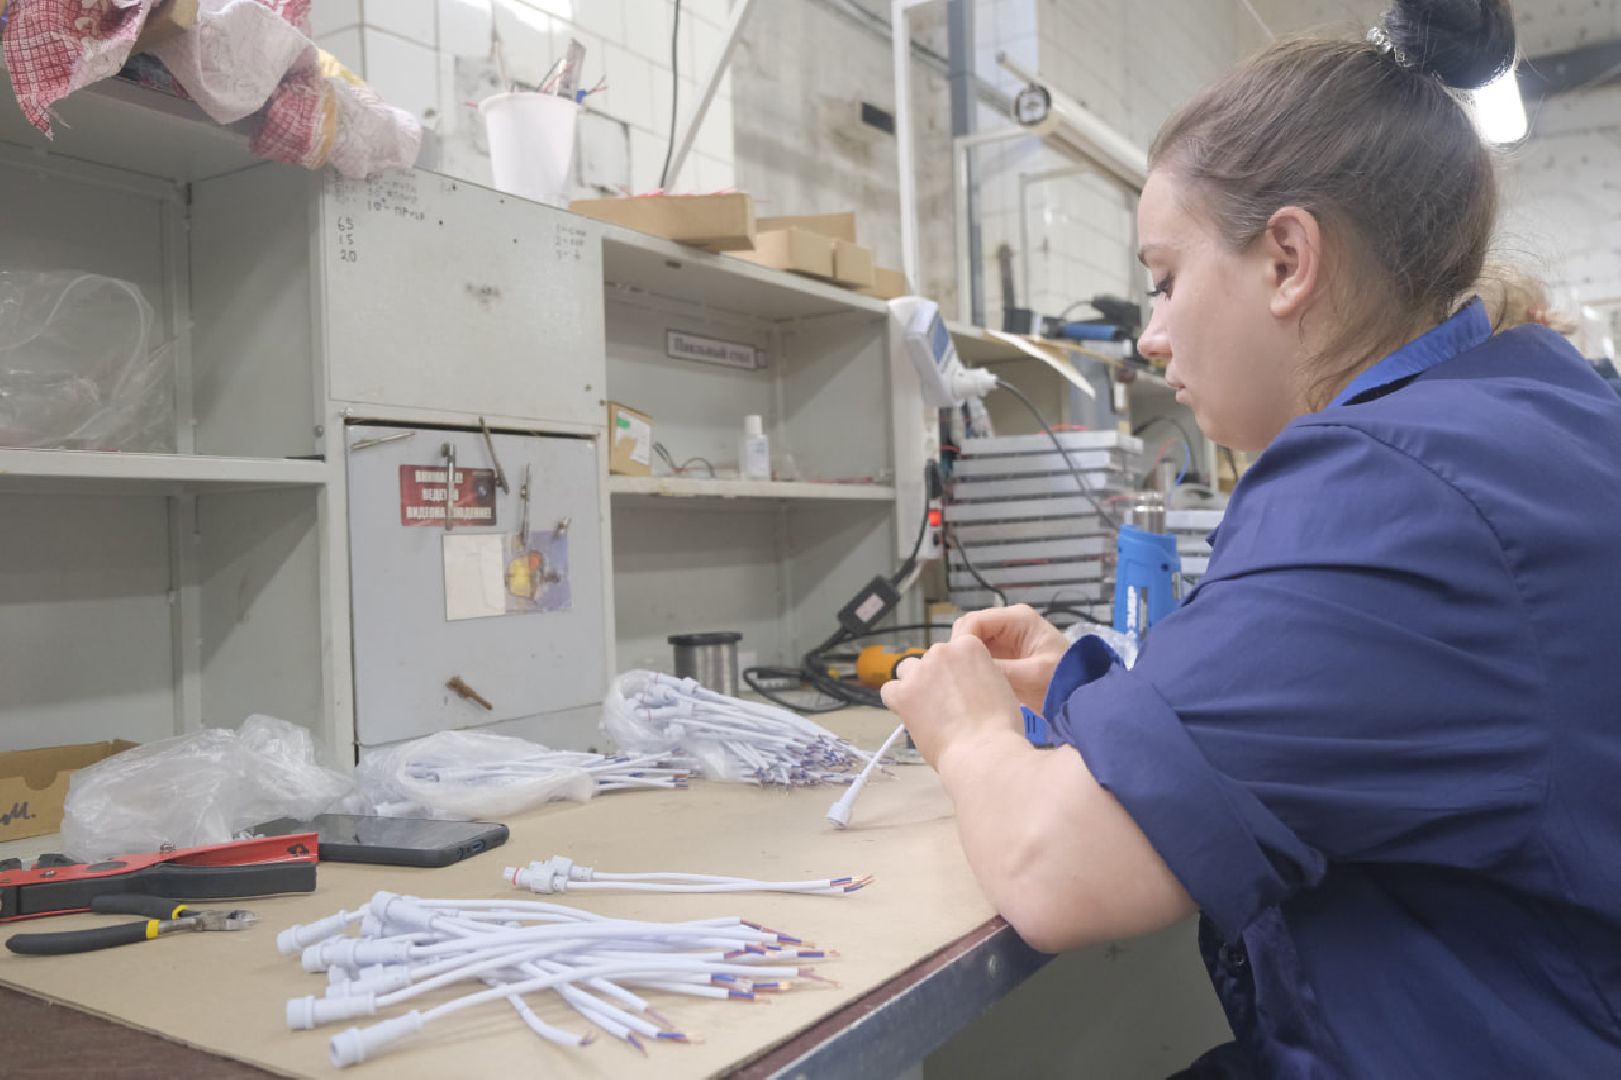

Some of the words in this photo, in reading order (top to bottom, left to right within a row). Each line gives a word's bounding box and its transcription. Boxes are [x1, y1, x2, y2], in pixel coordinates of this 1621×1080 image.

[337, 216, 354, 231] 65
[338, 234, 354, 245] 15
[340, 249, 357, 263] 20
